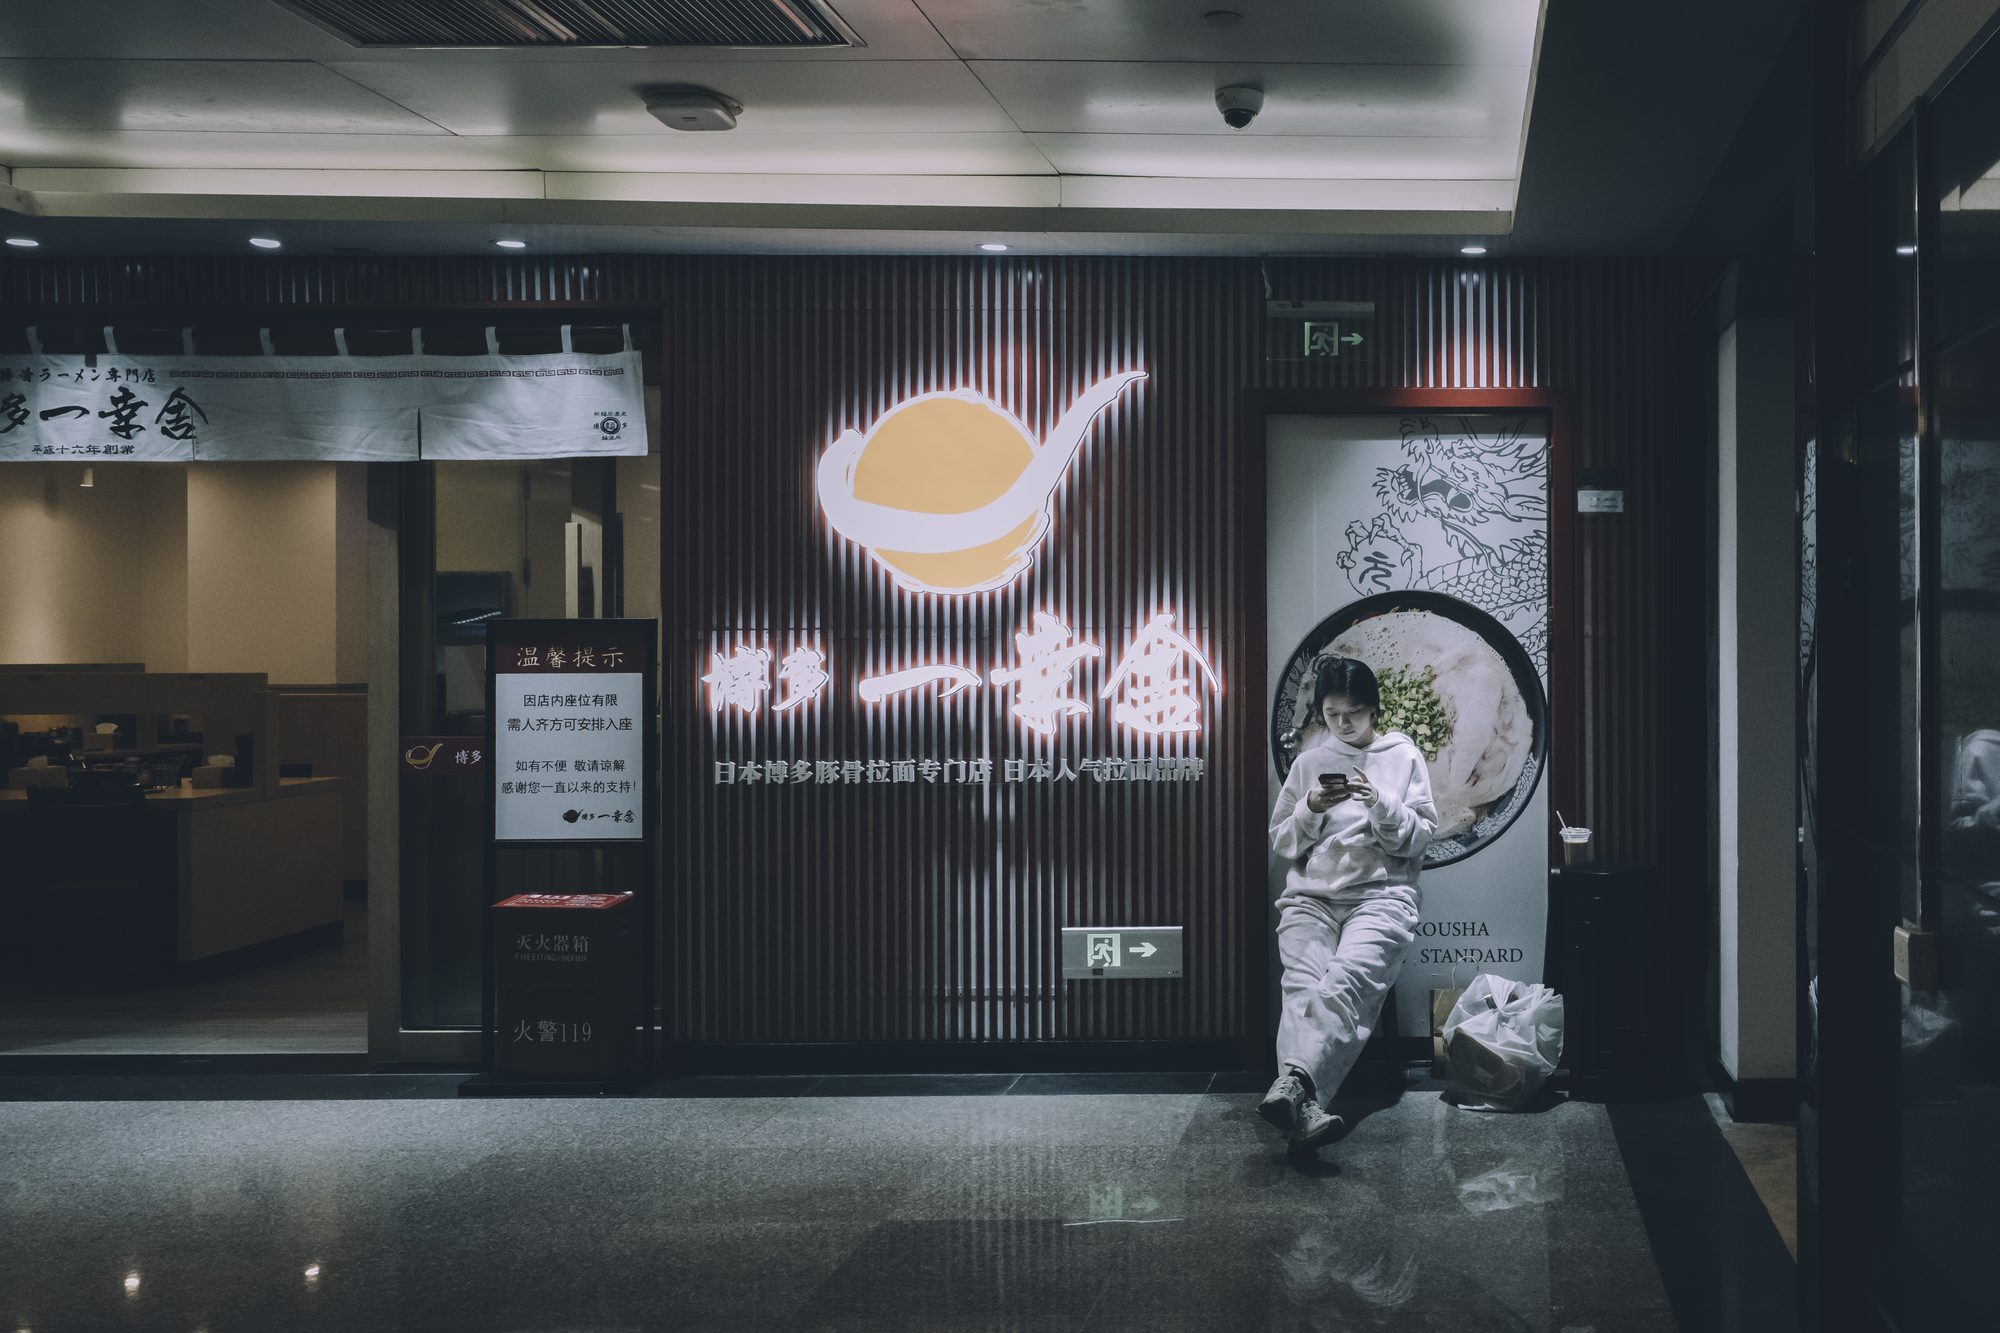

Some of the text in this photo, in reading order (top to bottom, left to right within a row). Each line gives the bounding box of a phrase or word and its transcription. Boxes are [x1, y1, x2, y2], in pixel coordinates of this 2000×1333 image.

[517, 646, 624, 668] 温馨提示
[523, 694, 618, 707] 因店内座位有限
[507, 717, 632, 731] 需人齐方可安排入座
[515, 760, 625, 772] 如有不便 敬请谅解
[714, 758, 1204, 785] 日本博多豚骨拉面专门店 日本人气拉面品牌
[516, 934, 589, 953] 灭火器箱
[1420, 948, 1523, 964] STANDARD
[514, 1019, 592, 1042] 火警119
